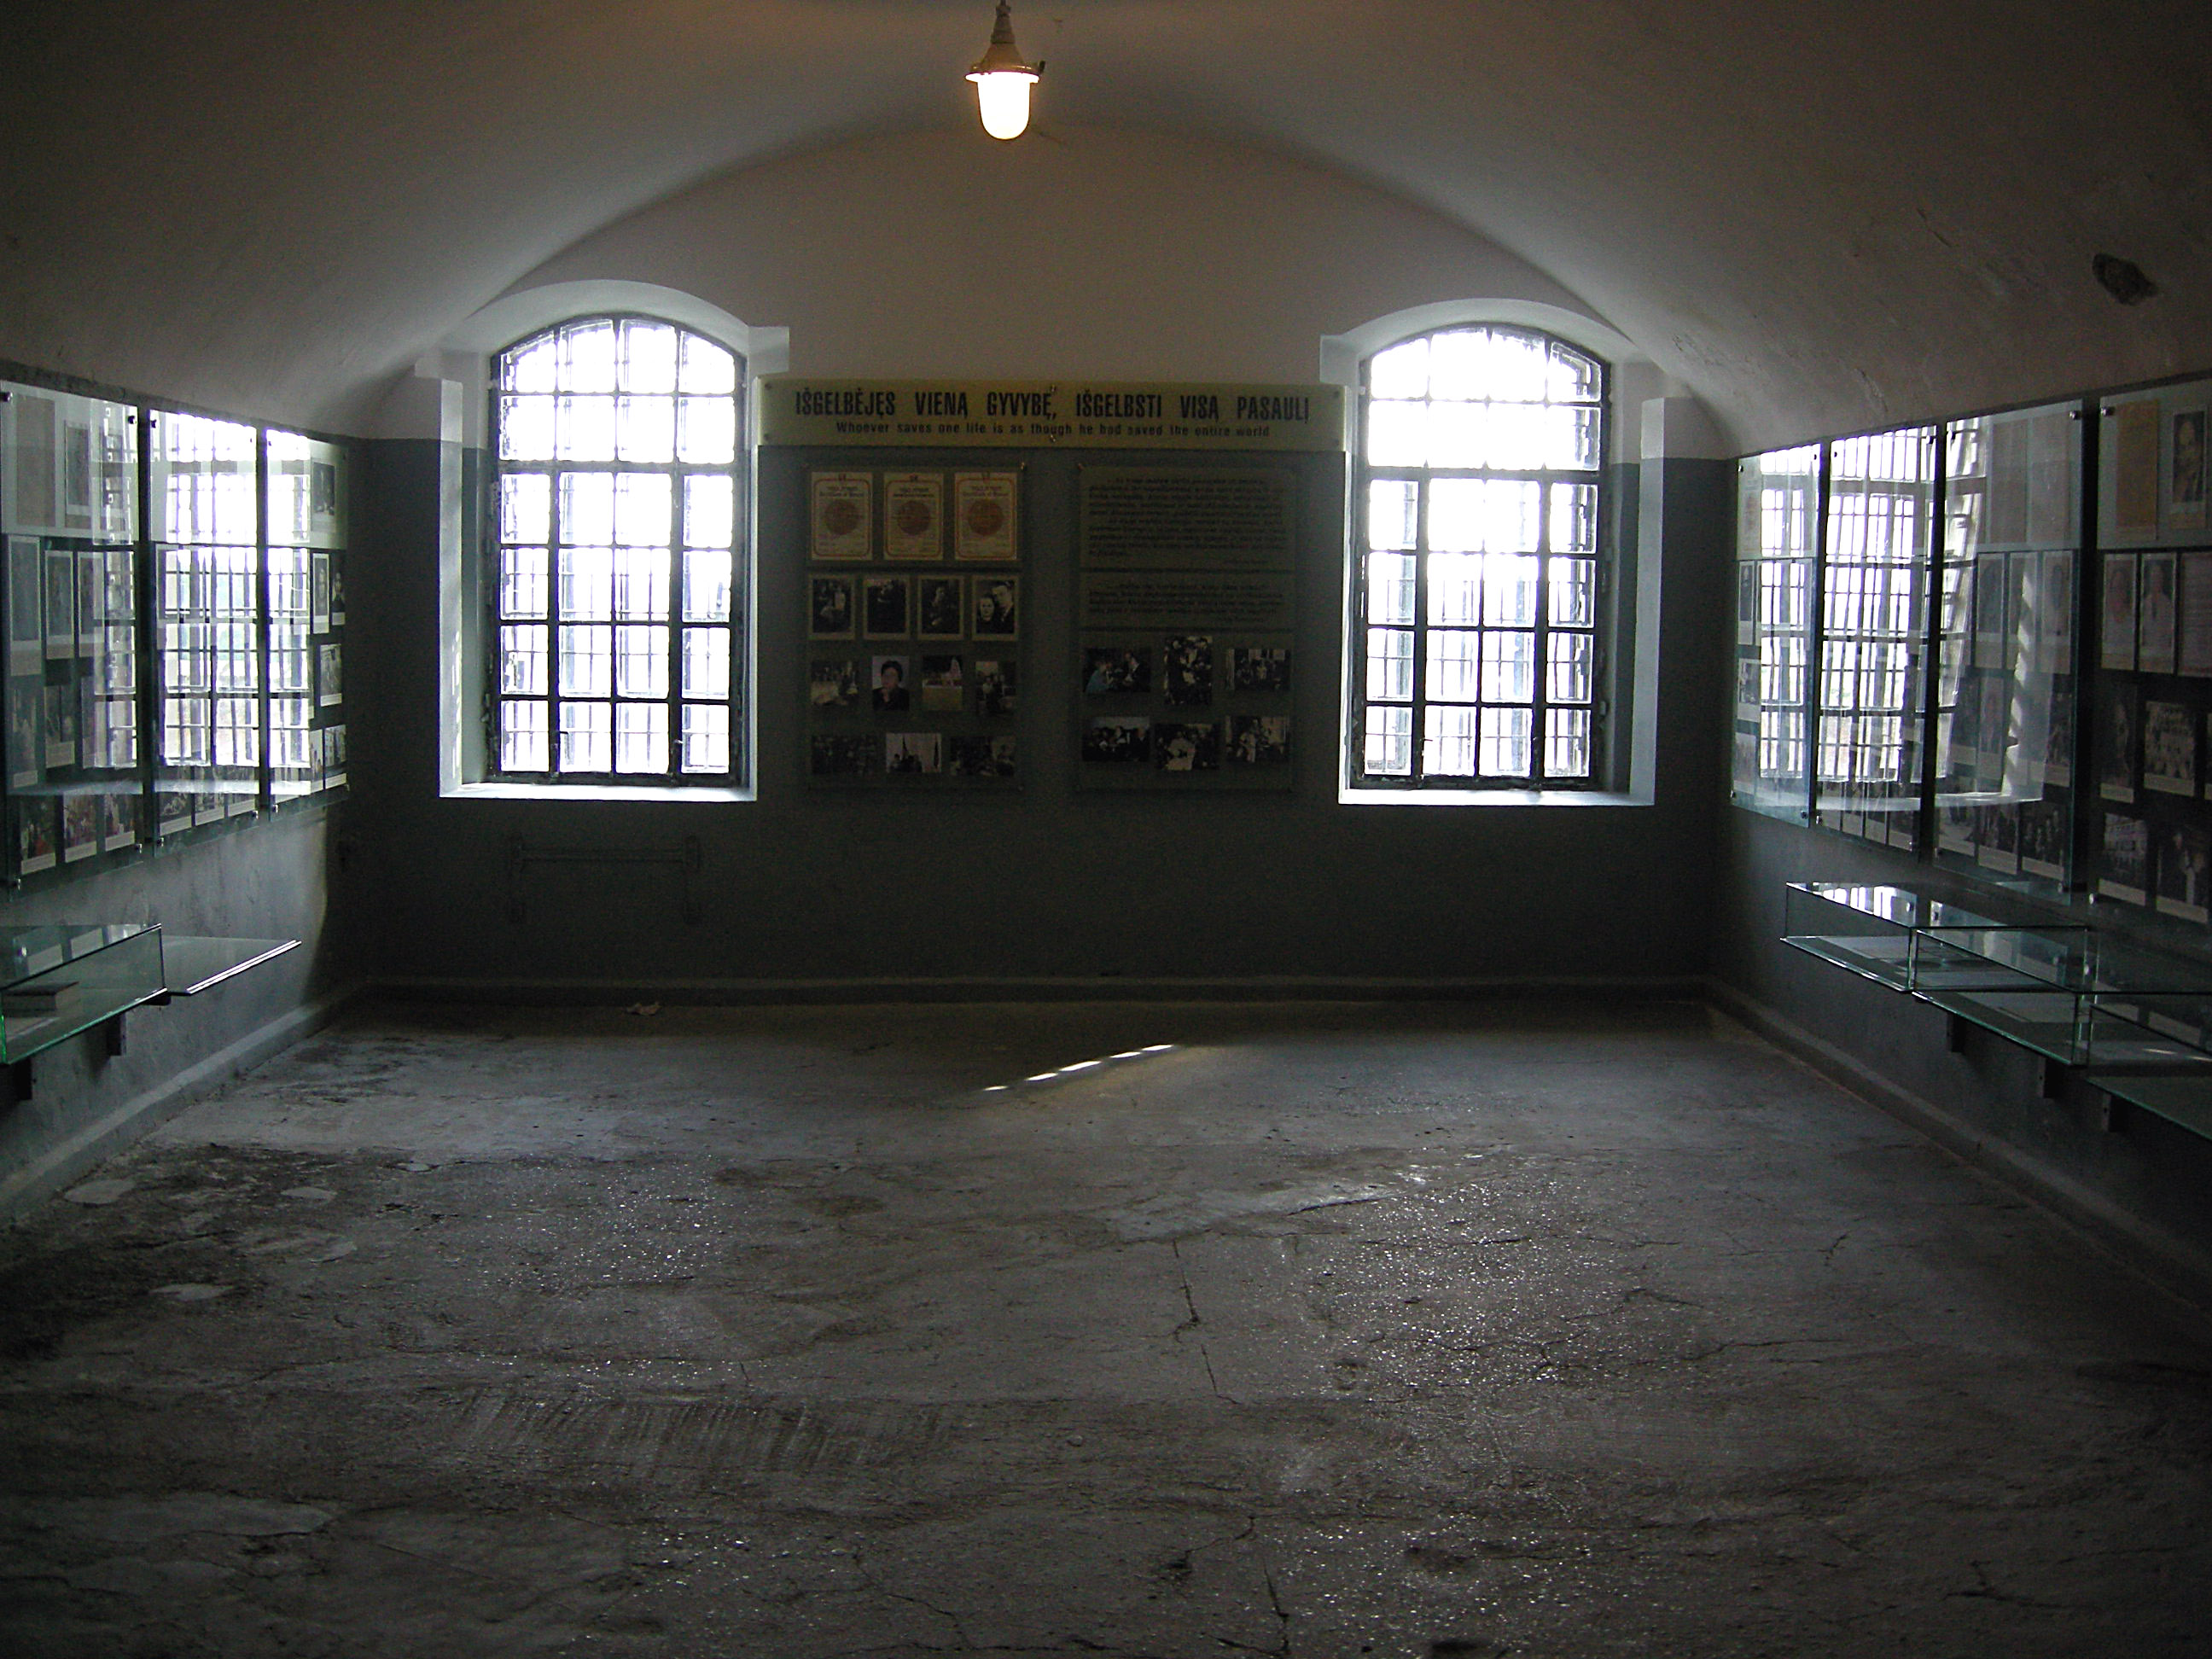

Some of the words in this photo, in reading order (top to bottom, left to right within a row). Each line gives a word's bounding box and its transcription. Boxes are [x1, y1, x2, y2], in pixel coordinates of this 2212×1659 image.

[915, 391, 969, 419] VIENĄ
[1076, 389, 1162, 417] IŠGELBSTI
[1179, 395, 1220, 422] VISĄ
[836, 422, 889, 433] Whoever
[897, 423, 932, 433] saves
[938, 423, 960, 433] one
[966, 422, 986, 433] life
[993, 422, 1004, 434] is
[1010, 424, 1024, 434] as
[1030, 423, 1073, 436] though
[1079, 424, 1093, 434] he
[1099, 424, 1121, 435] had
[1126, 424, 1163, 436] saved
[1170, 425, 1189, 436] the
[1194, 425, 1231, 437] entire
[1235, 425, 1271, 437] world
